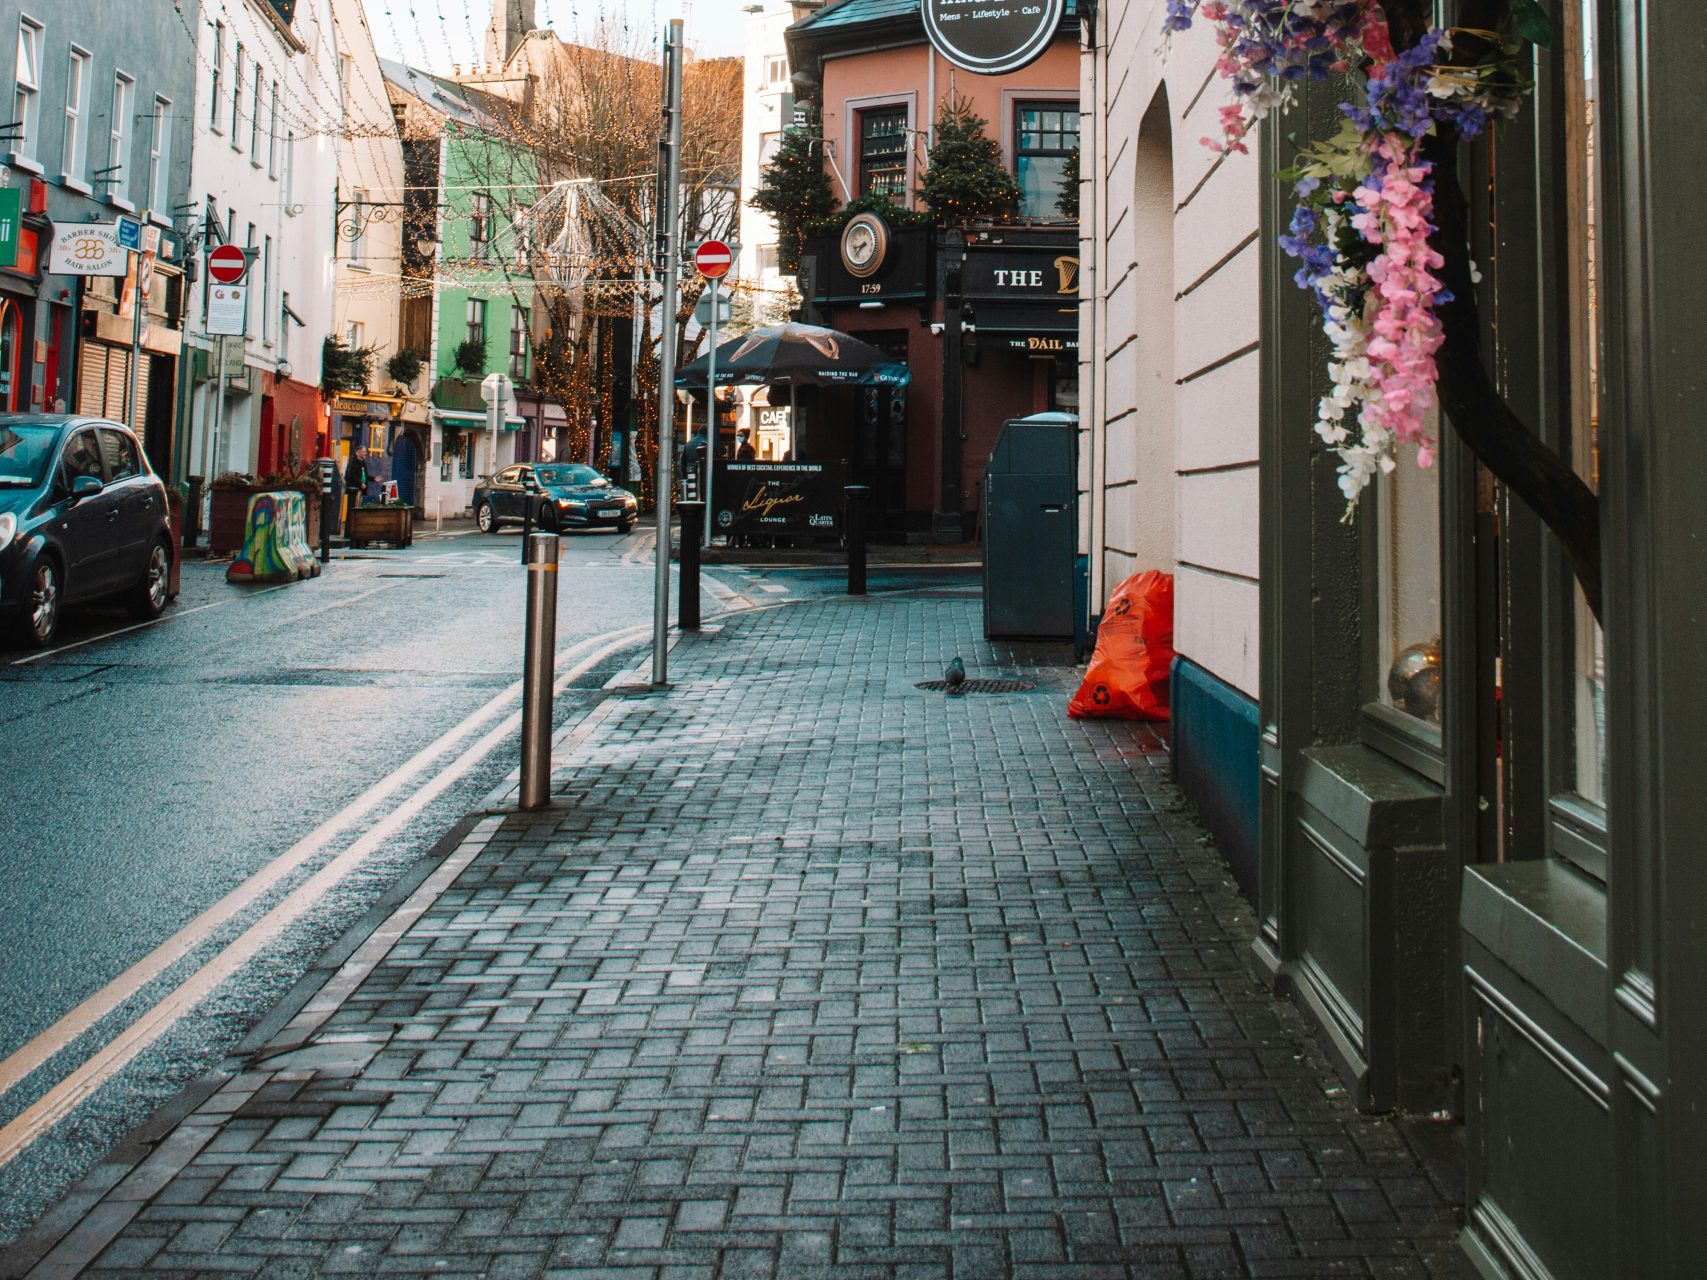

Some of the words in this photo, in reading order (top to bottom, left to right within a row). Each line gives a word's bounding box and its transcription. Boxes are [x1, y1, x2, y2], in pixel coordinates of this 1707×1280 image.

[939, 13, 961, 22] Mens
[972, 8, 1010, 19] Lifestyle
[1021, 5, 1041, 15] Café
[60, 229, 96, 244] BARBER
[98, 229, 119, 245] SHO
[64, 257, 84, 271] HAIR
[86, 258, 113, 271] SALON
[993, 269, 1043, 287] THE
[1009, 340, 1026, 348] THE
[1027, 337, 1063, 350] DÁIL
[742, 485, 804, 516] Liquor
